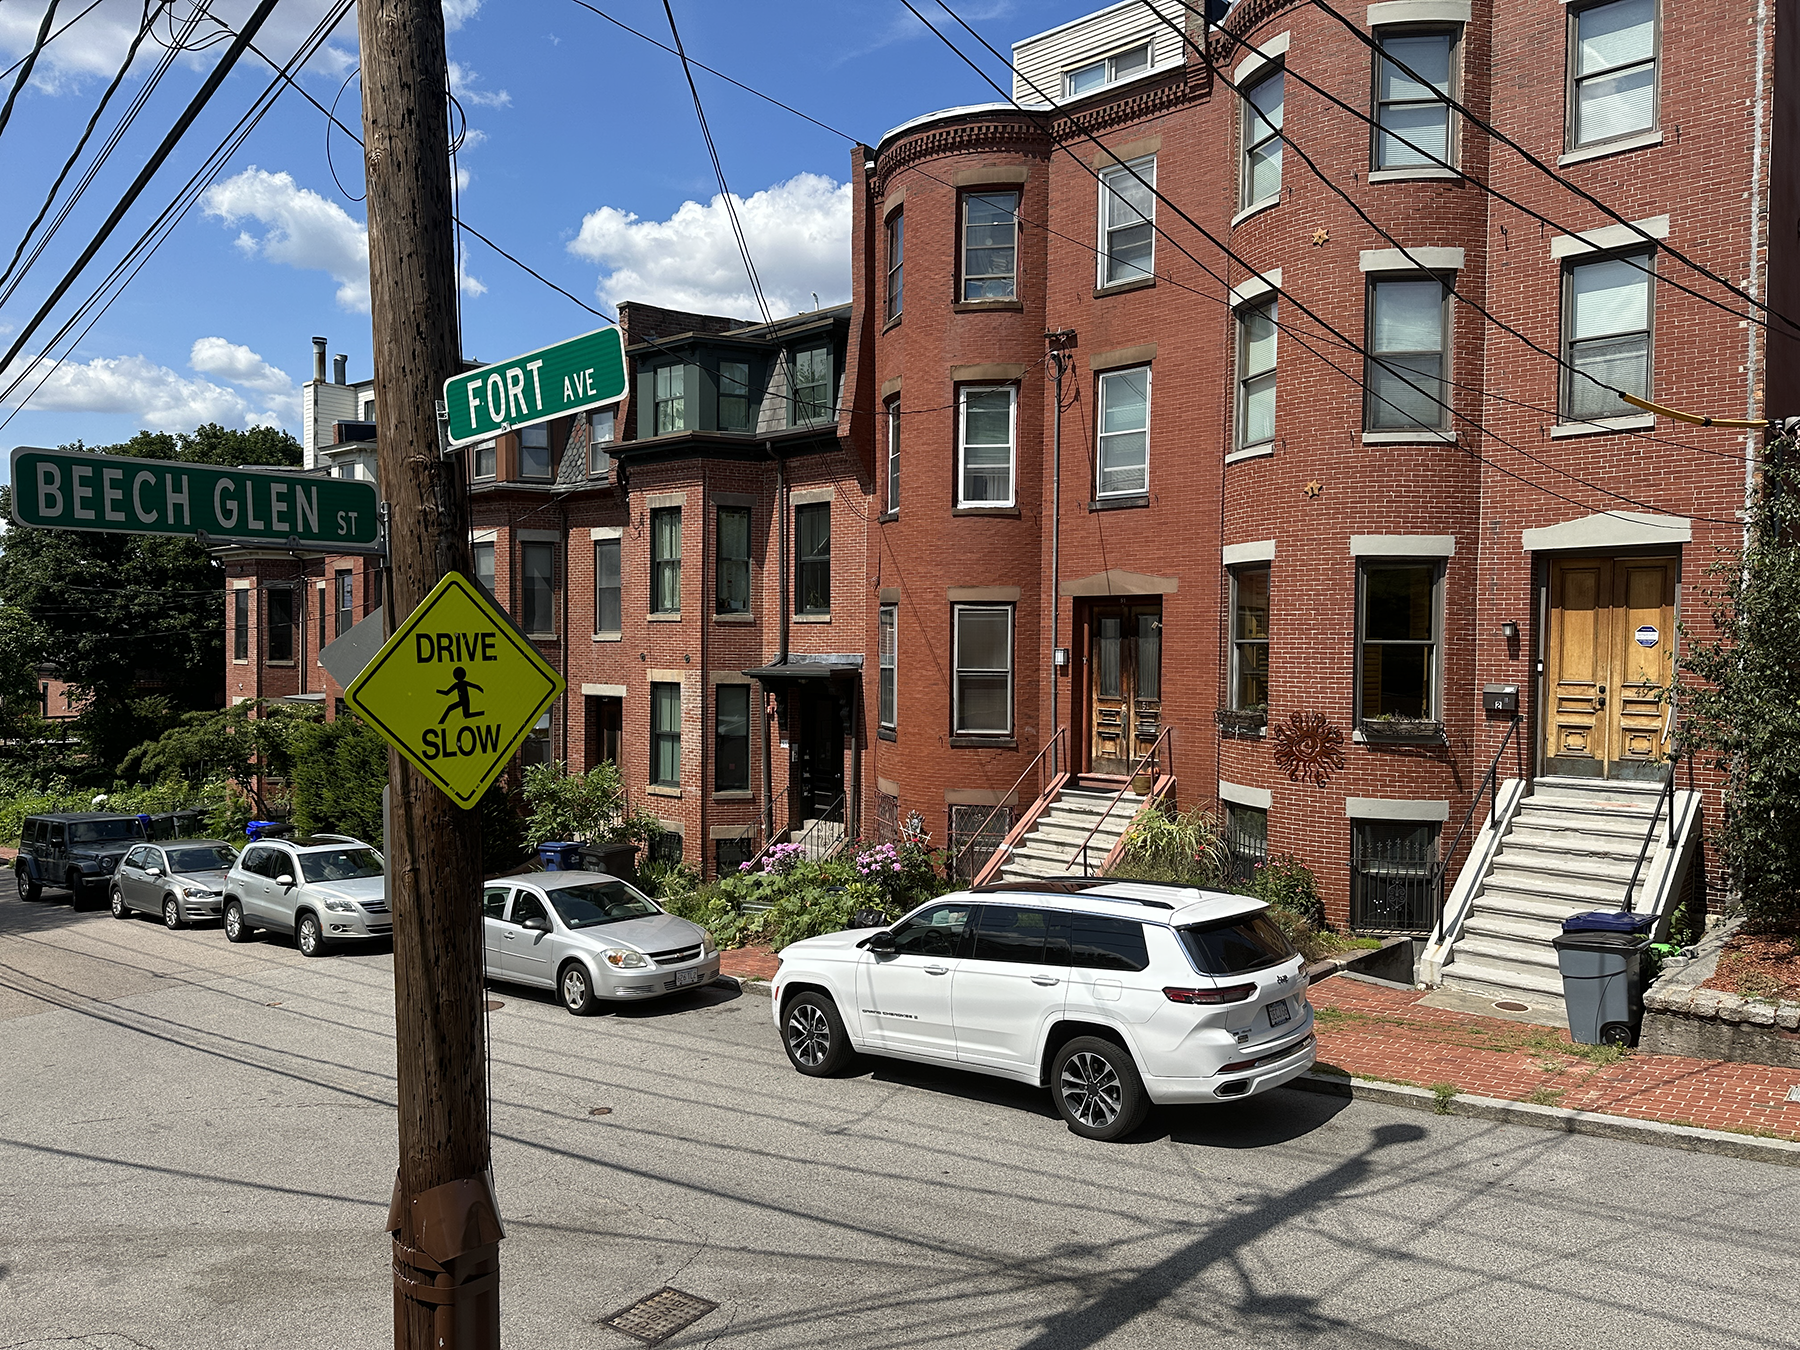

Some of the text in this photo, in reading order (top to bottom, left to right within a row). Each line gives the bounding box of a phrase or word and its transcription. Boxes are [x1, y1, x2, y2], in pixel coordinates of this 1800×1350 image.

[467, 359, 597, 429] FORT AVE
[36, 462, 358, 536] BEECH GLEN ST
[415, 632, 498, 664] DRIVE
[1635, 688, 1649, 698] 49
[421, 724, 501, 760] SLOW
